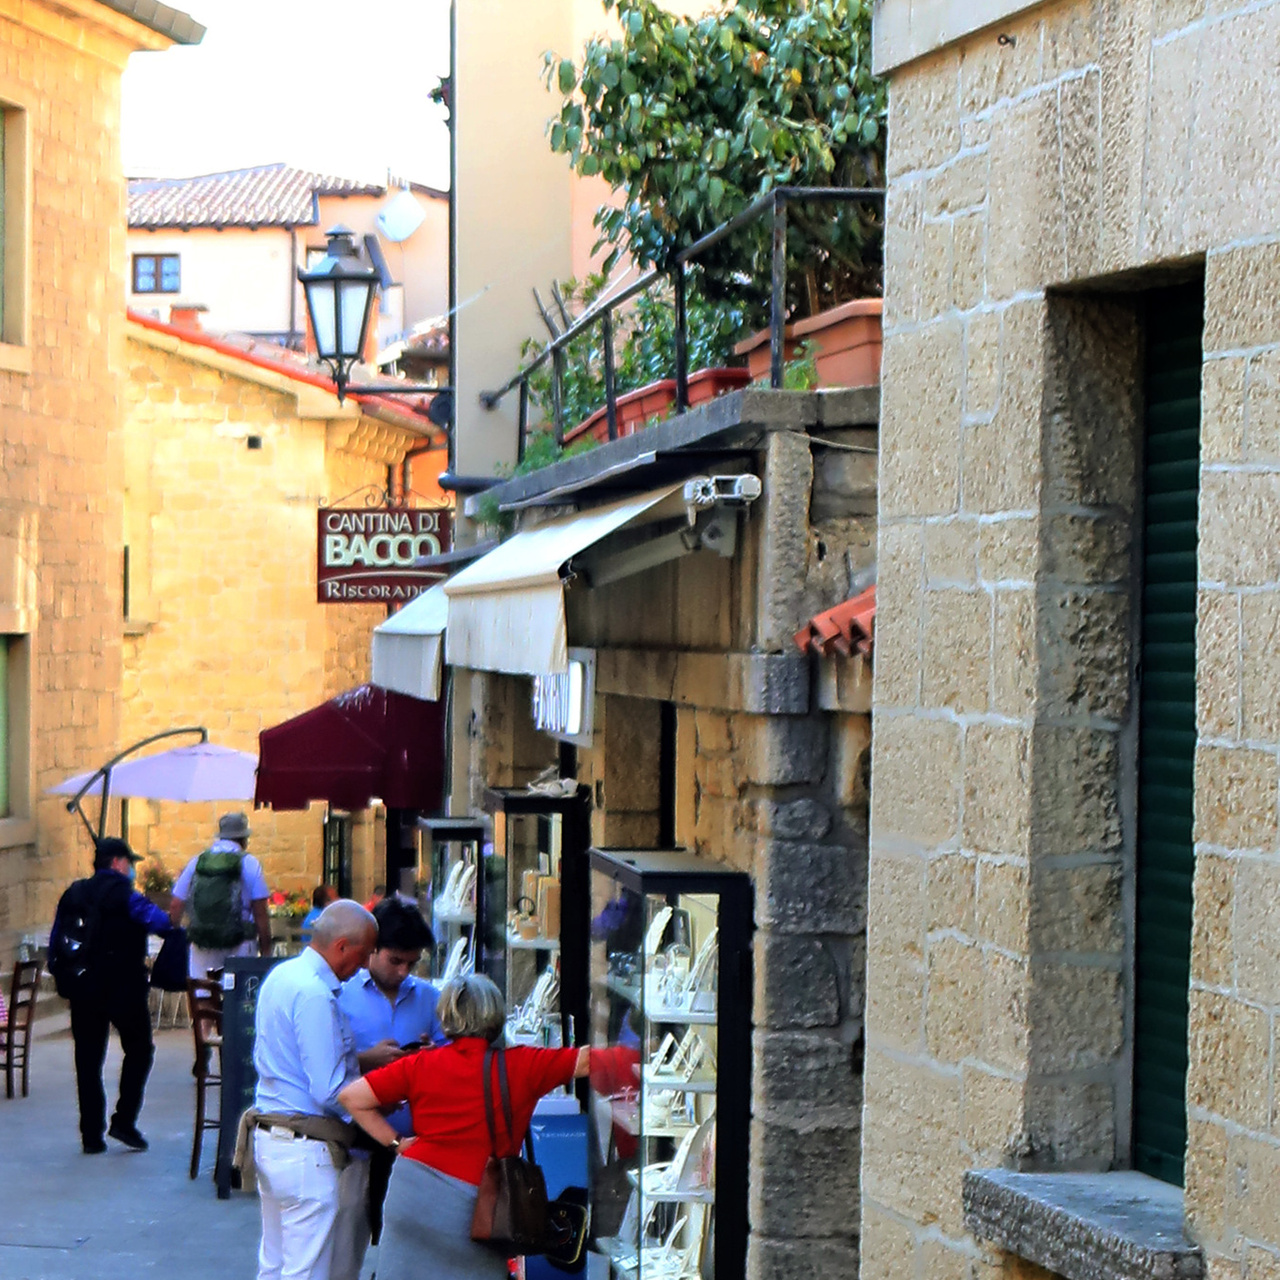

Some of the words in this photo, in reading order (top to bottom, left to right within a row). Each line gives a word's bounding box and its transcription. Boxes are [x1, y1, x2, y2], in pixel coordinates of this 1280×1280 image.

[326, 513, 412, 532] CANTINA
[419, 512, 440, 532] DI
[325, 533, 441, 567] BACCO
